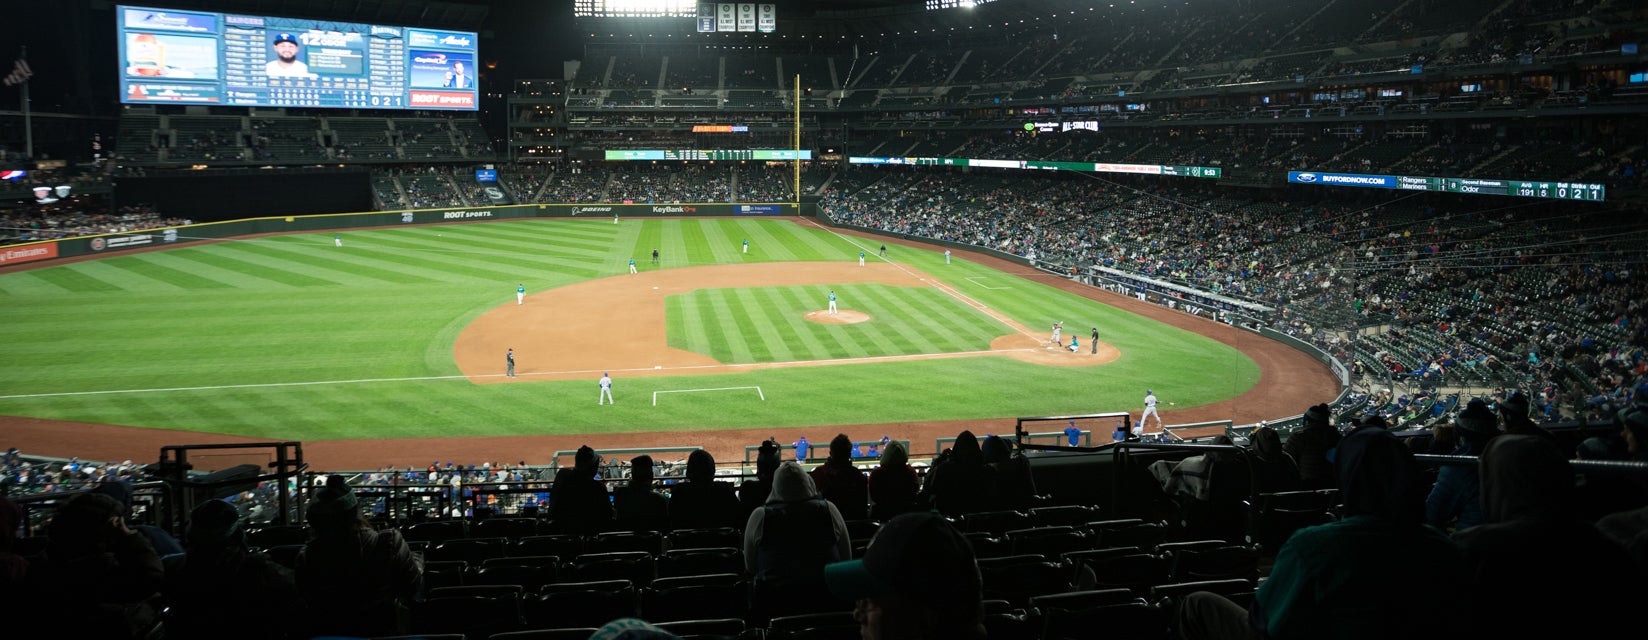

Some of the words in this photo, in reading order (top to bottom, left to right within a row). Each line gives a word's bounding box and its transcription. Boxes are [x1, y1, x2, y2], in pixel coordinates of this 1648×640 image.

[300, 32, 320, 46] 12
[372, 97, 379, 106] 0
[384, 97, 390, 106] 2
[395, 97, 400, 106] 1
[412, 93, 438, 104] ROOT
[1085, 122, 1098, 132] CLUB
[1323, 176, 1385, 184] BUYFORDNOW.COM
[1559, 188, 1566, 198] 0
[1574, 189, 1581, 198] 2
[1592, 190, 1597, 200] 1
[6, 248, 48, 259] Emirates
